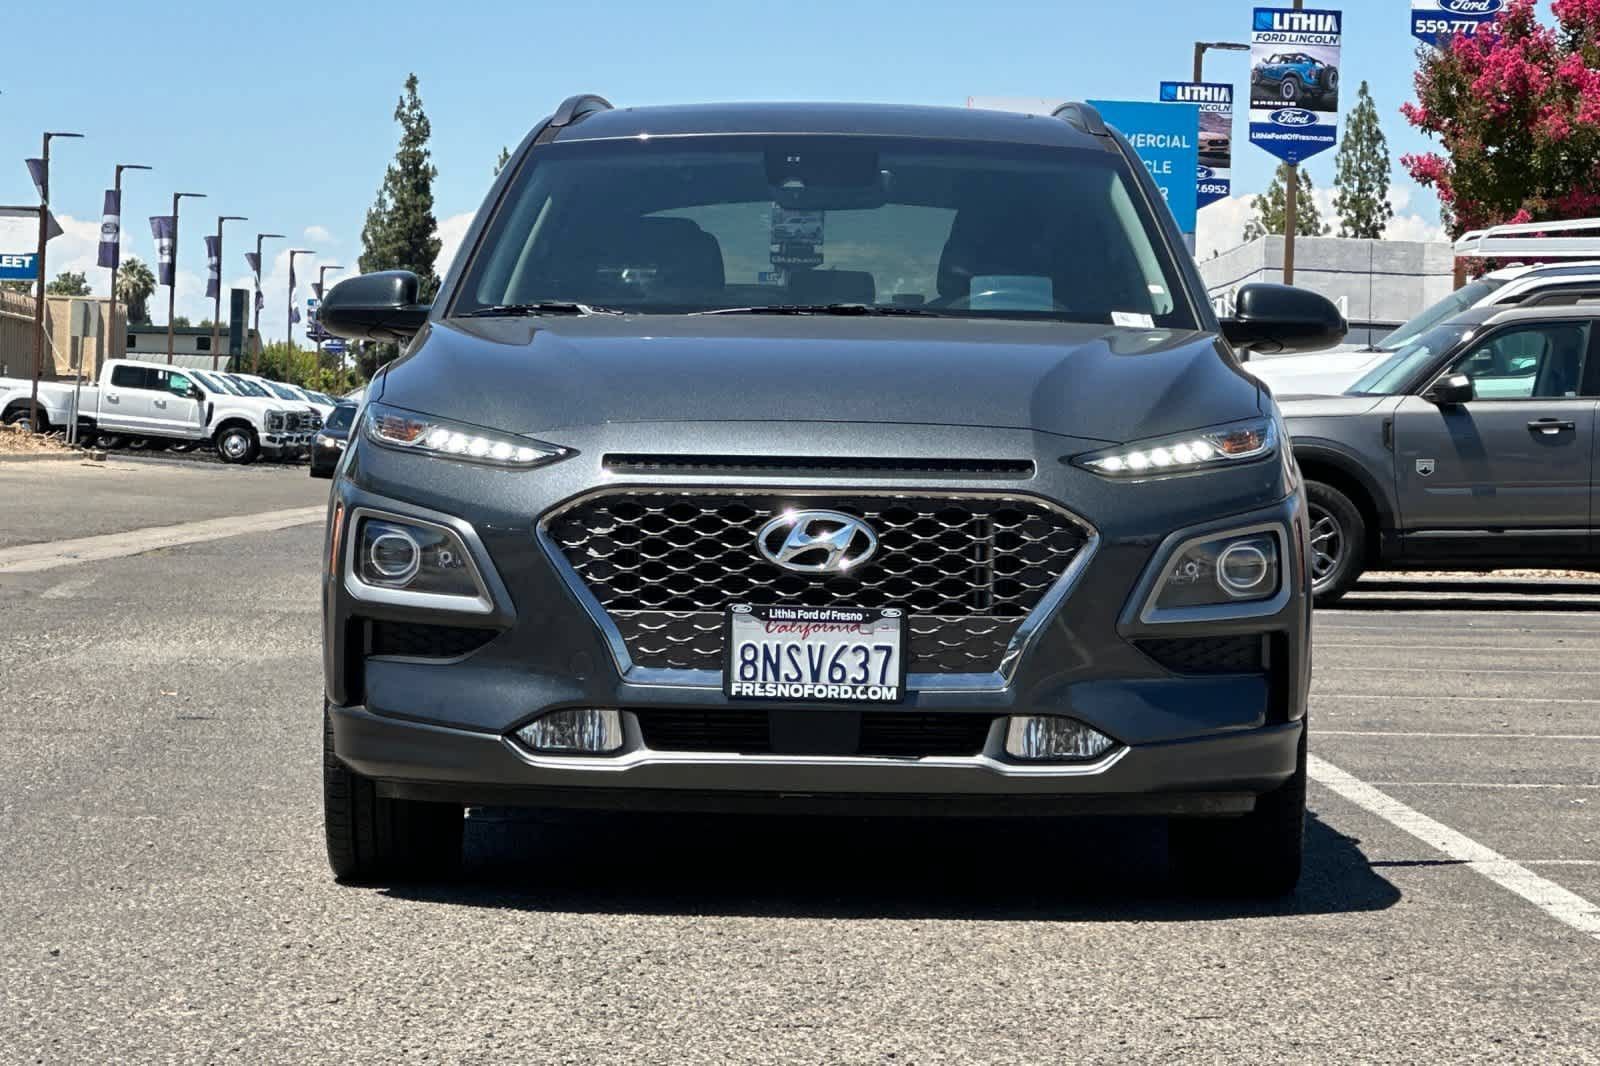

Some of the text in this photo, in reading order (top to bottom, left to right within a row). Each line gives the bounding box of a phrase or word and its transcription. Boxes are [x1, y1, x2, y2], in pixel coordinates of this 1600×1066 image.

[1273, 12, 1339, 32] LITHIA
[1256, 33, 1338, 44] FORD LINCOLN
[1176, 85, 1231, 102] LITHIA
[1278, 110, 1309, 124] Ford
[0, 255, 33, 268] EET
[769, 608, 863, 621] Lithia Ford of Fresno
[765, 619, 873, 640] California
[739, 643, 893, 685] 8NSV637
[731, 683, 897, 700] FRESNOFORD.COM
